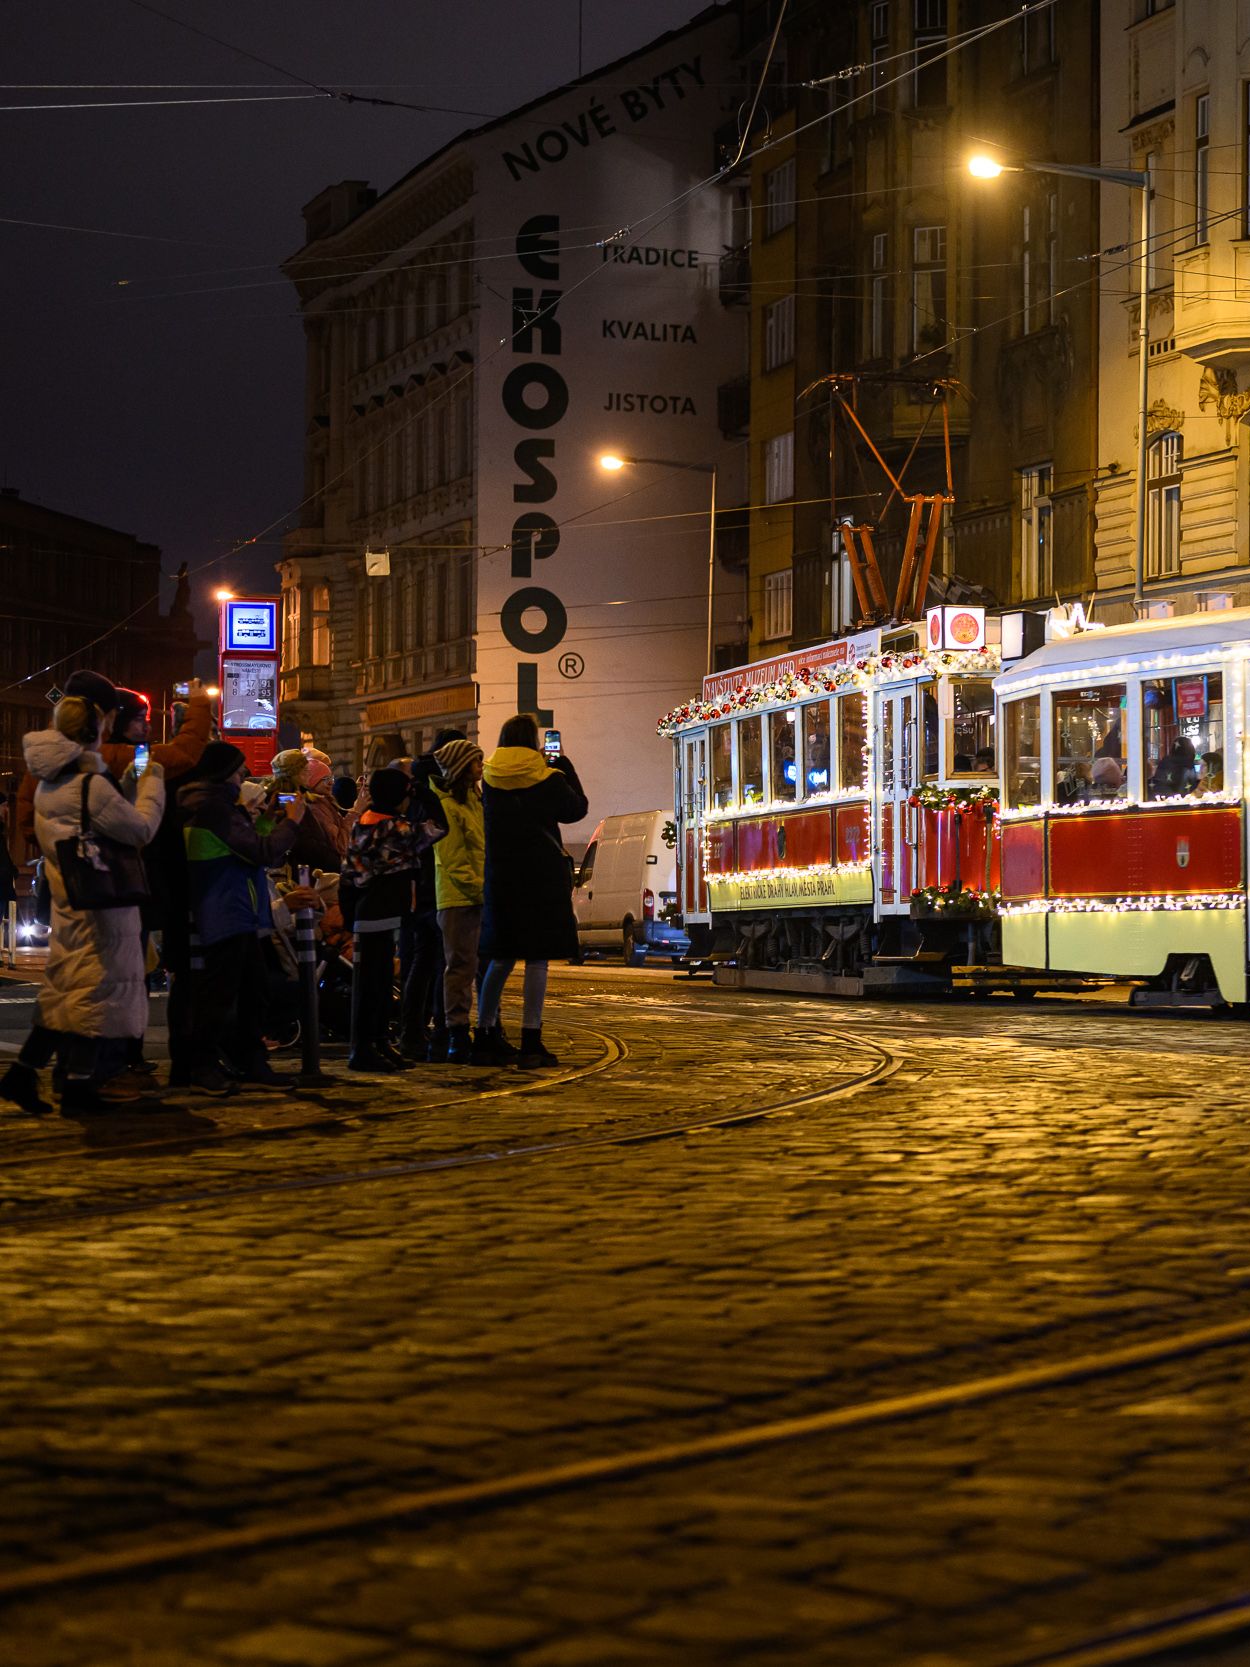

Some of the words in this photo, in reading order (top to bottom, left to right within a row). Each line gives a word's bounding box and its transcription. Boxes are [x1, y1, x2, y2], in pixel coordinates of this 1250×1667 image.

[502, 96, 617, 182] NOVÉ
[620, 57, 705, 124] BYTY
[602, 245, 699, 269] TRADICE
[602, 319, 697, 345] KVALITA
[603, 391, 697, 416] JISTOTA
[500, 214, 570, 729] EKOSPOL
[246, 680, 256, 688] 17
[261, 680, 271, 688] 91
[746, 665, 776, 687] MUZEUM
[777, 660, 795, 678] MHD
[246, 689, 256, 697] 26
[261, 689, 271, 697] 93
